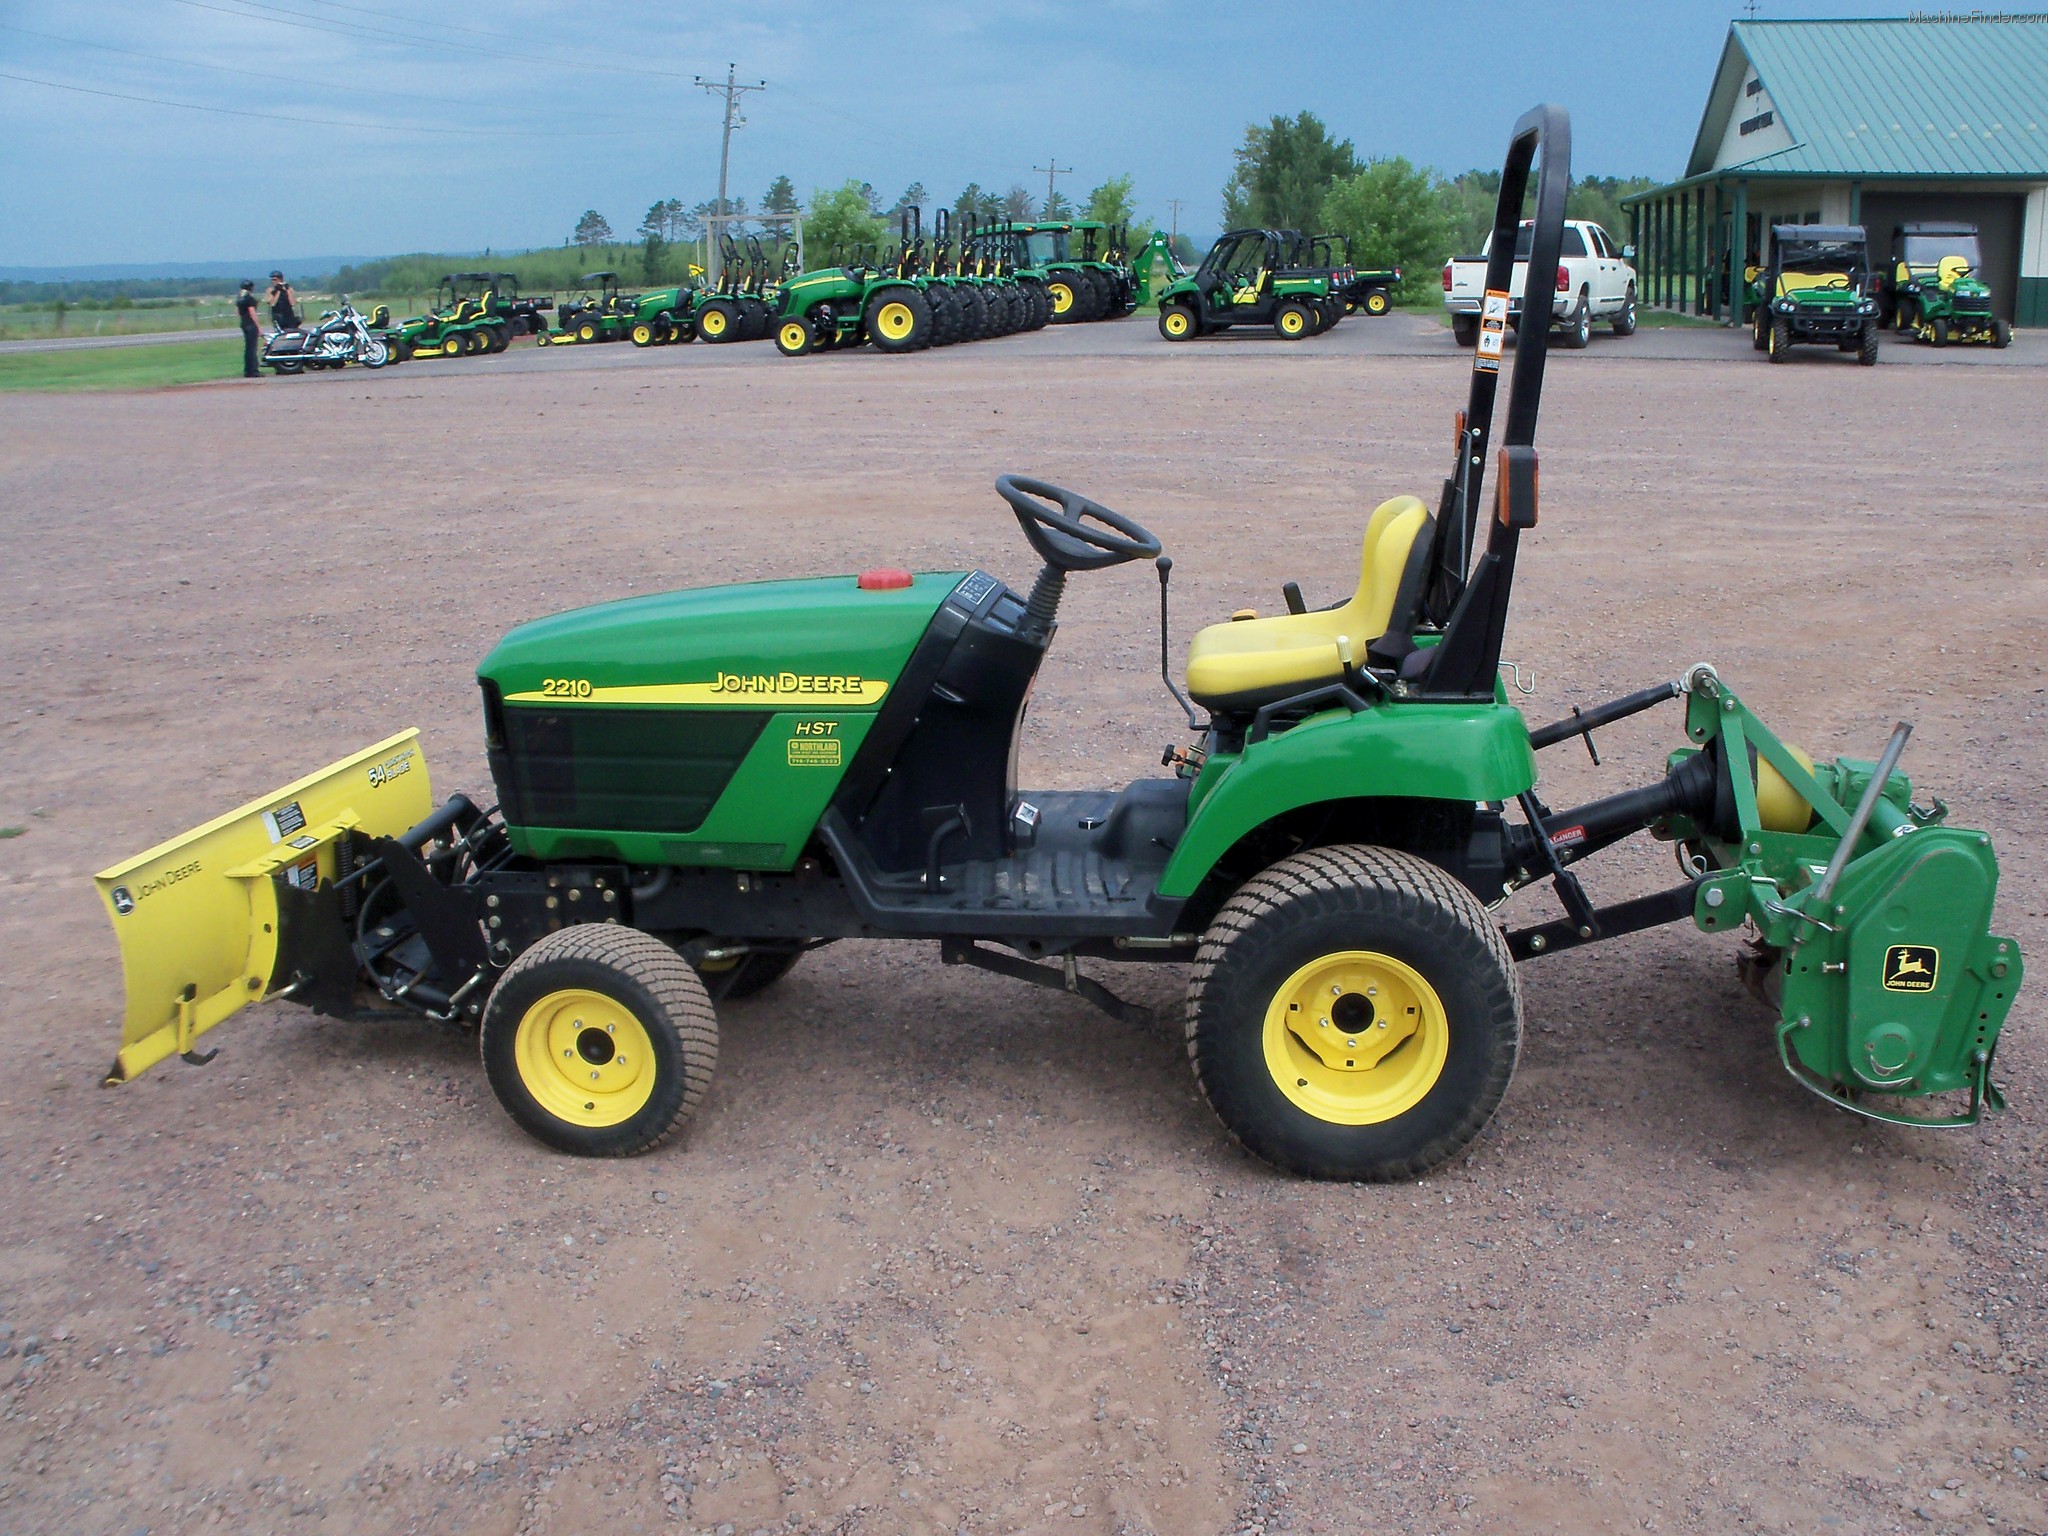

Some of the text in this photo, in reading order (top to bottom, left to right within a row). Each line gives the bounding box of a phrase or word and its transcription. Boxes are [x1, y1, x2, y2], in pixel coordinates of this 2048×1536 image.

[542, 678, 592, 697] 2210
[710, 671, 862, 693] JOHN DEERE
[795, 721, 839, 735] HST
[368, 764, 387, 788] 54
[137, 860, 203, 901] JOHN DEERE
